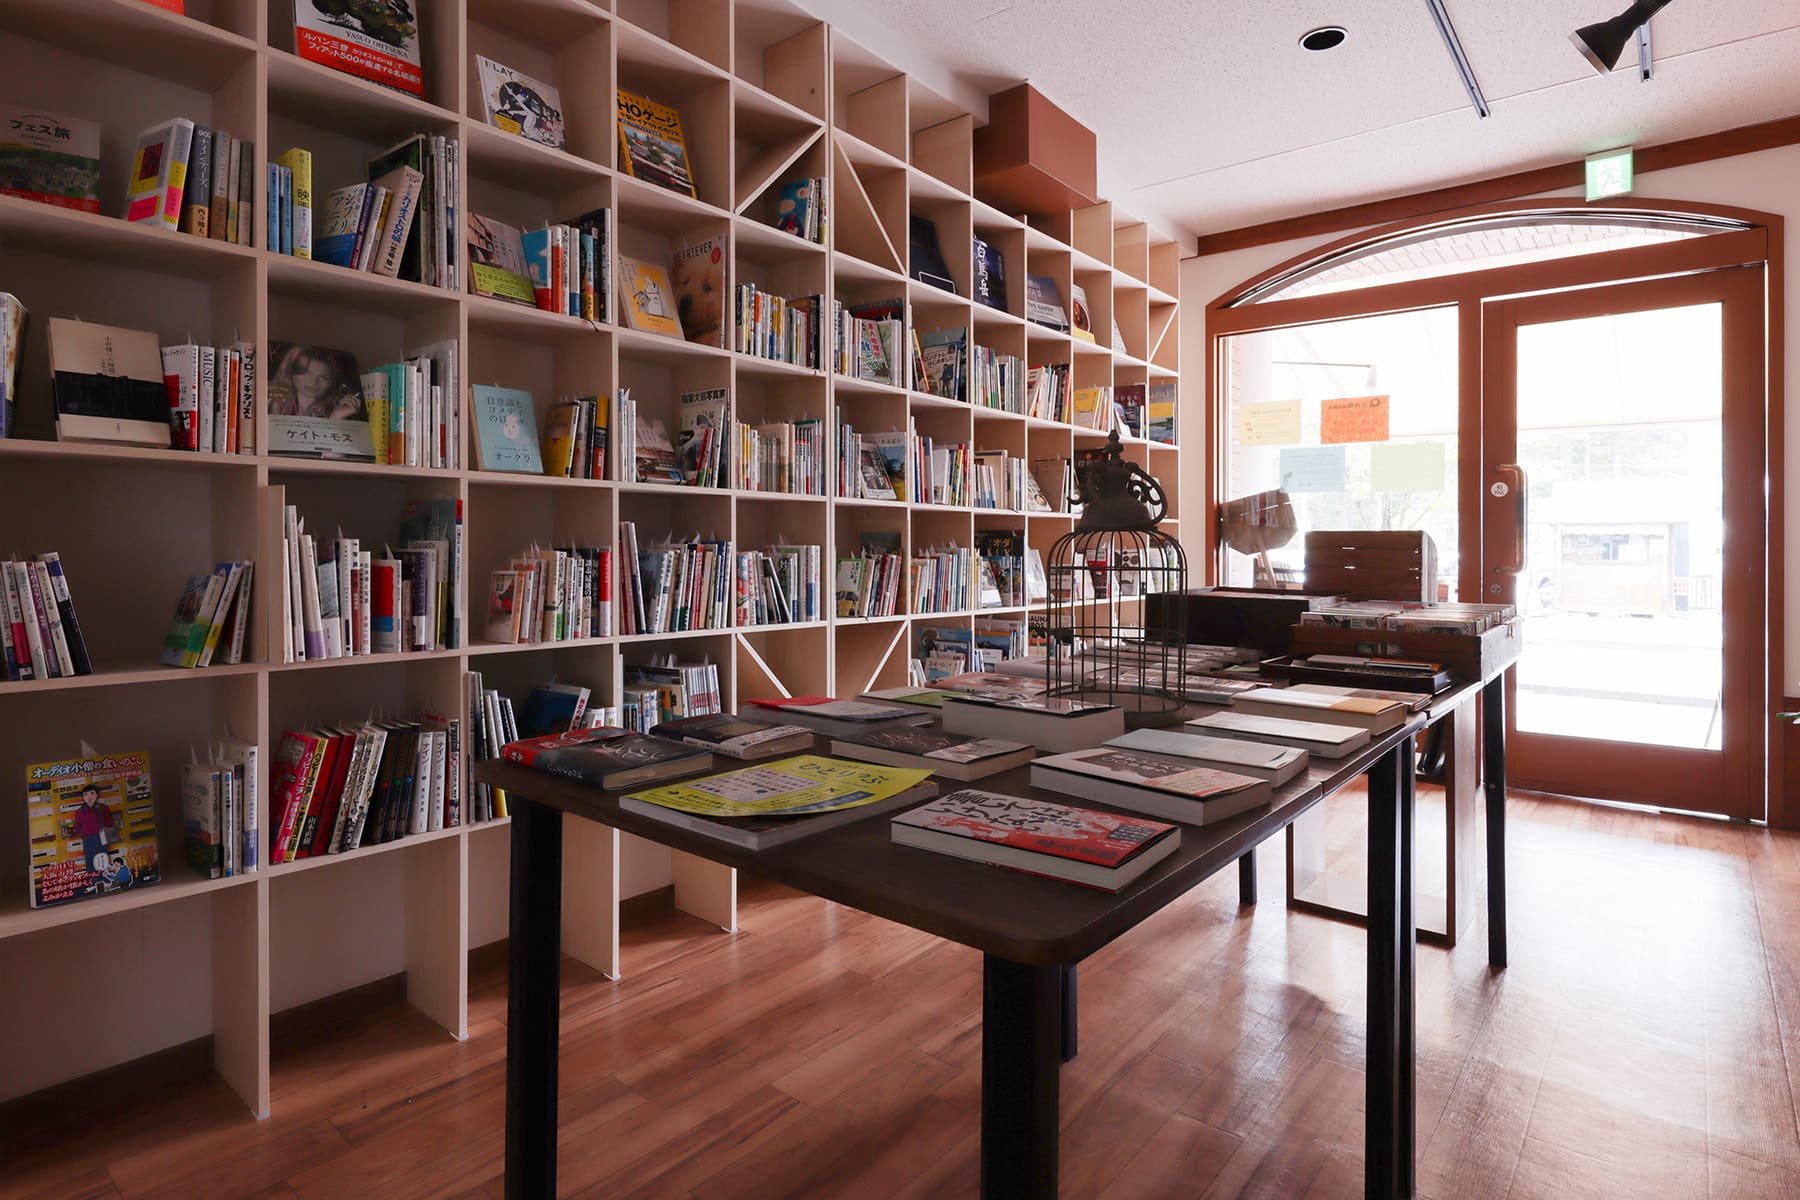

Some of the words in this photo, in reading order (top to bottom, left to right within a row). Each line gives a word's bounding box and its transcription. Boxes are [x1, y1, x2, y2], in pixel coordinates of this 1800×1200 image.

[10, 120, 71, 139] フェス旅
[392, 196, 412, 244] カリオストロの城
[203, 351, 213, 387] MUSIC
[485, 395, 521, 406] 自意識と
[286, 429, 353, 443] ケイト・モス
[493, 450, 530, 460] オークラ
[32, 755, 145, 779] オーディオ小僧の食いのこし
[924, 802, 1045, 832] いけない
[946, 791, 1074, 819] 書いては
